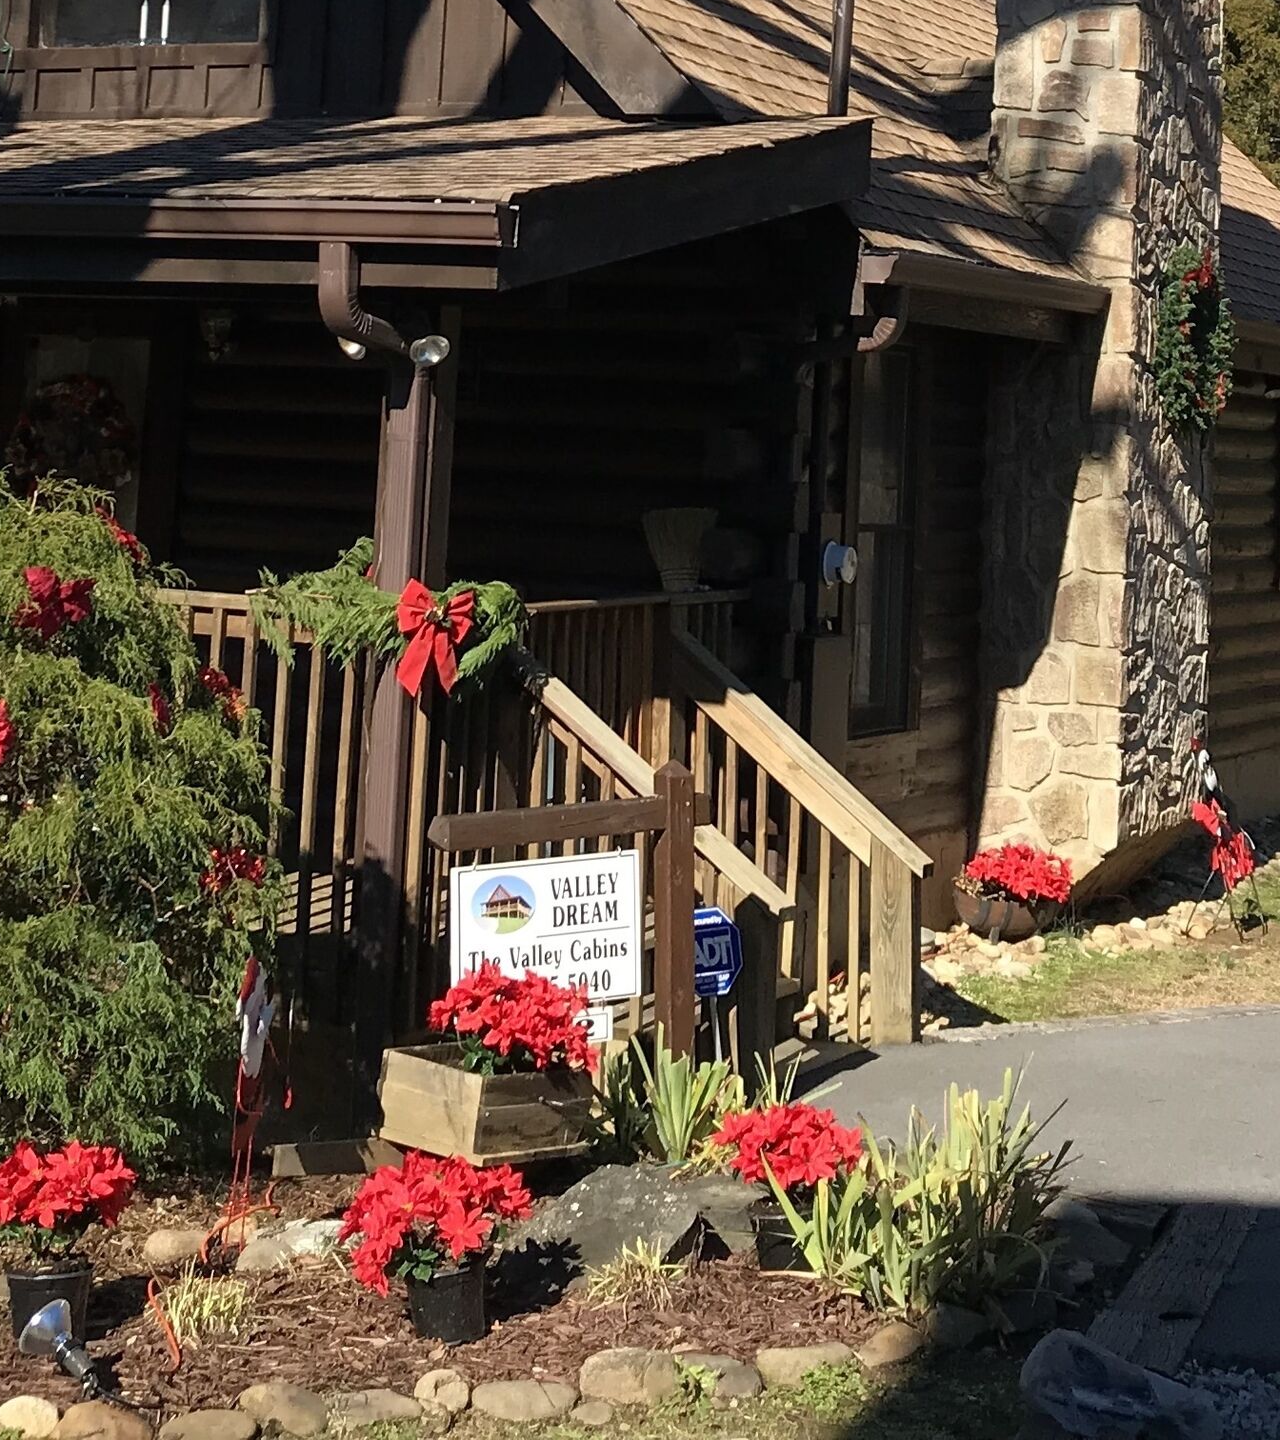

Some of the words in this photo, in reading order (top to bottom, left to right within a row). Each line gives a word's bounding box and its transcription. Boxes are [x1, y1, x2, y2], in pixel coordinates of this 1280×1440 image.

[551, 872, 619, 900] VALLEY
[552, 900, 619, 928] DREAM
[510, 944, 563, 969] Valley
[570, 938, 628, 962] Cabins
[694, 935, 730, 968] ADT
